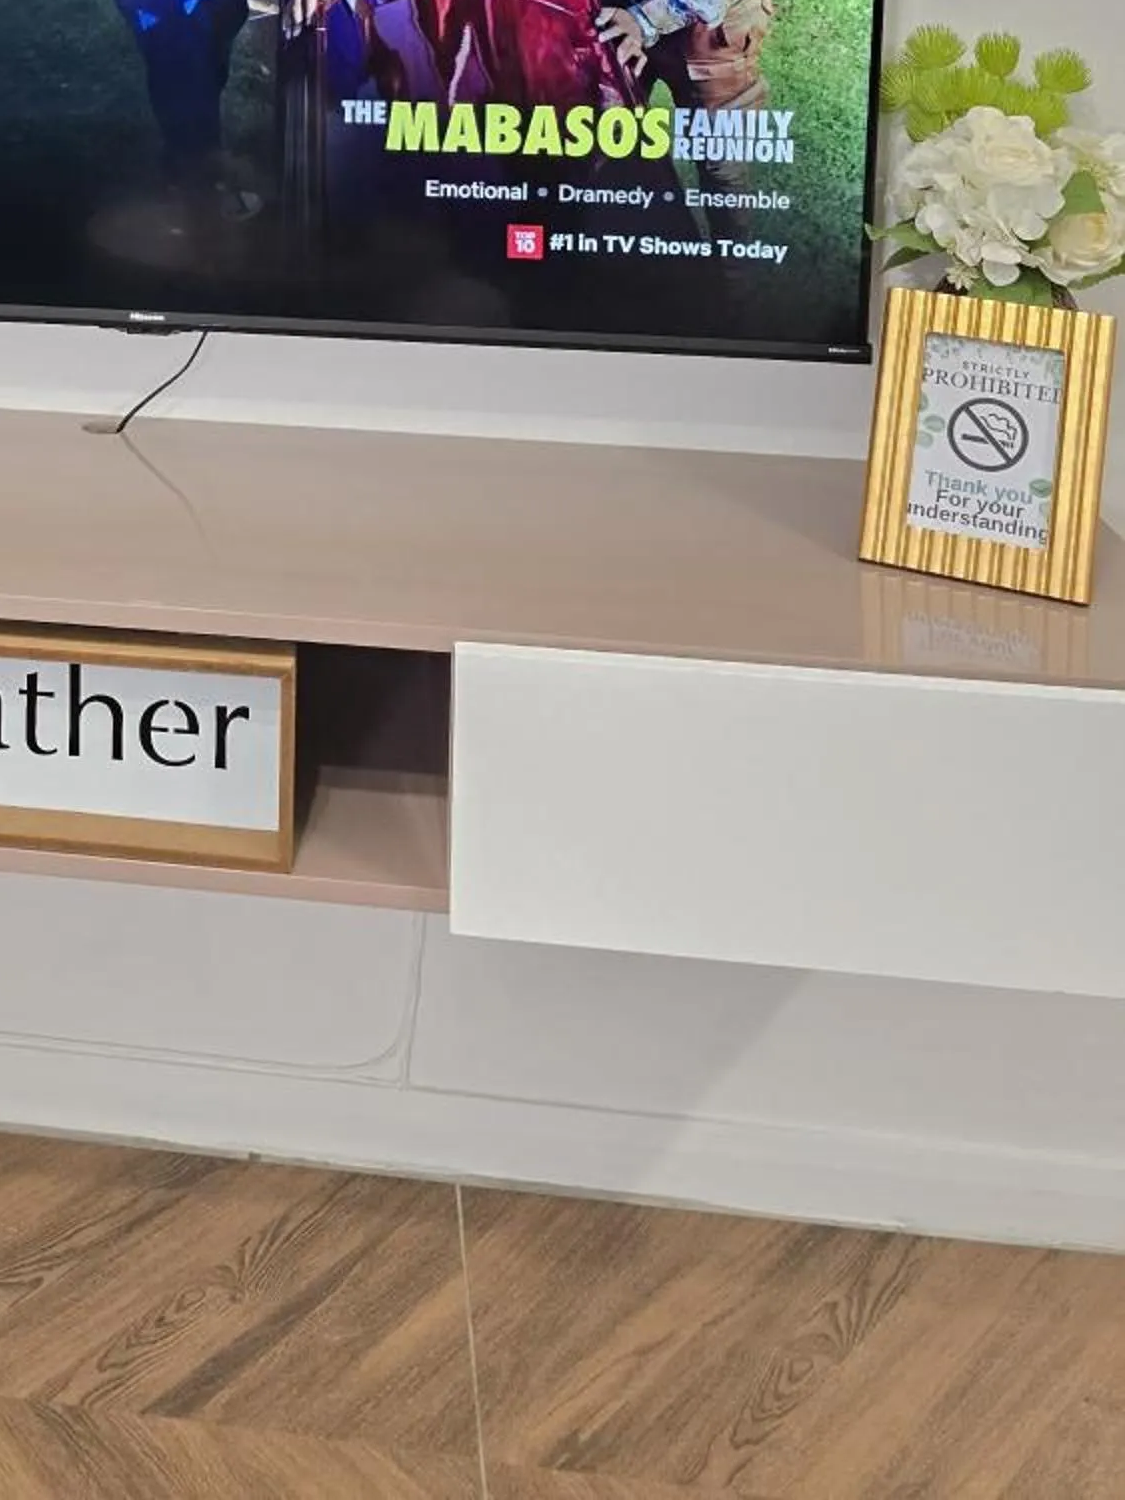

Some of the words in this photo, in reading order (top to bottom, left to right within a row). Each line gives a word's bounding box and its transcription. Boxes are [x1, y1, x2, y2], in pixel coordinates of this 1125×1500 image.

[342, 100, 387, 124] THE
[385, 100, 671, 159] MABASO'S
[674, 108, 794, 138] FAMILY
[673, 137, 794, 163] REUNION
[425, 180, 528, 201] Emotional
[558, 184, 654, 208] Dramedy
[685, 189, 791, 210] Ensemble
[516, 239, 535, 253] 10
[549, 233, 574, 251] #1
[578, 233, 597, 252] in
[603, 236, 636, 253] TV
[639, 237, 712, 257] Shows
[717, 240, 789, 263] Today
[962, 360, 1031, 379] STRICTLY
[925, 470, 988, 497] Thank
[994, 484, 1033, 505] you
[936, 489, 971, 509] For
[976, 499, 1025, 519] your
